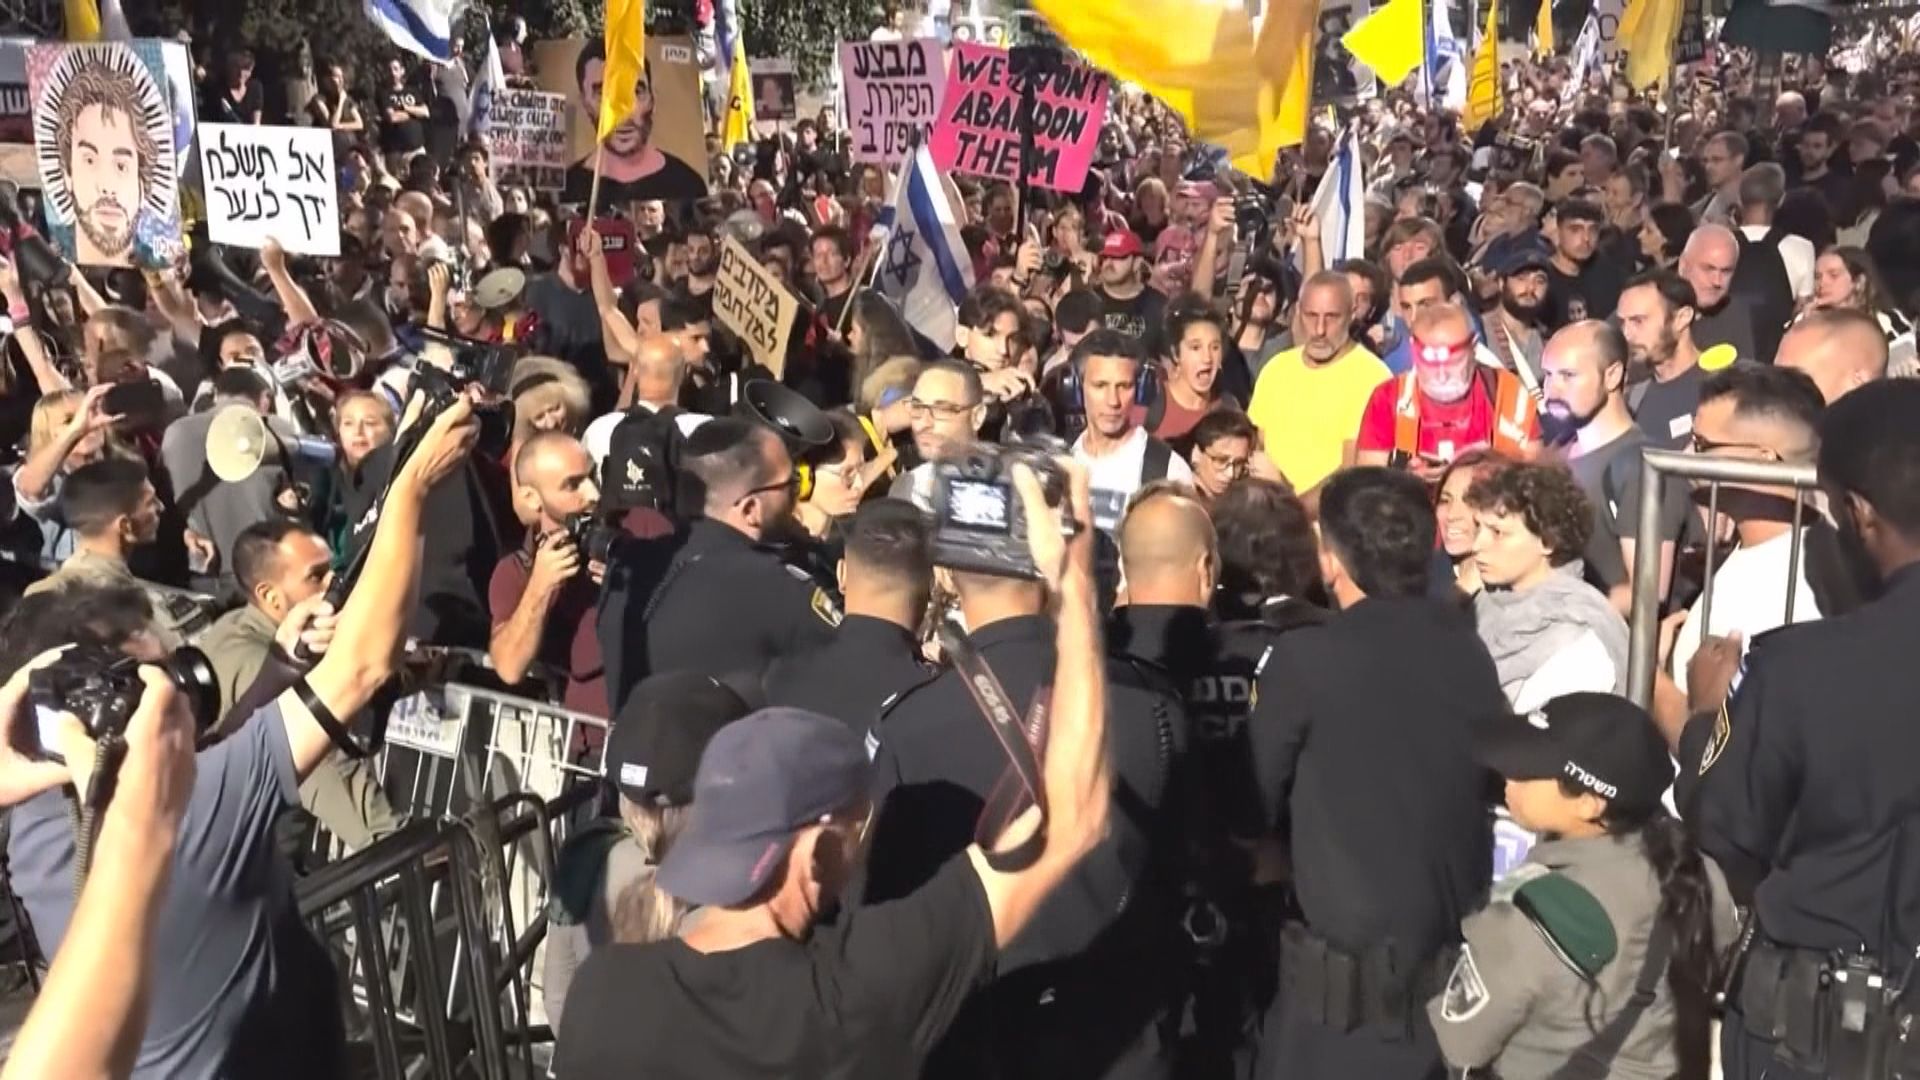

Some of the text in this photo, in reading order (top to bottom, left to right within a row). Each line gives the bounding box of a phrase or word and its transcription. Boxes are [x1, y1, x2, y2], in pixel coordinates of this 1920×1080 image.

[853, 41, 926, 79] מבצע
[957, 50, 1006, 86] WE
[862, 82, 934, 118] הפקרת
[205, 129, 327, 183] אל תשלח
[955, 131, 1060, 185] THEM
[213, 179, 327, 241] ידך לנער
[1564, 760, 1618, 799] משטרה
